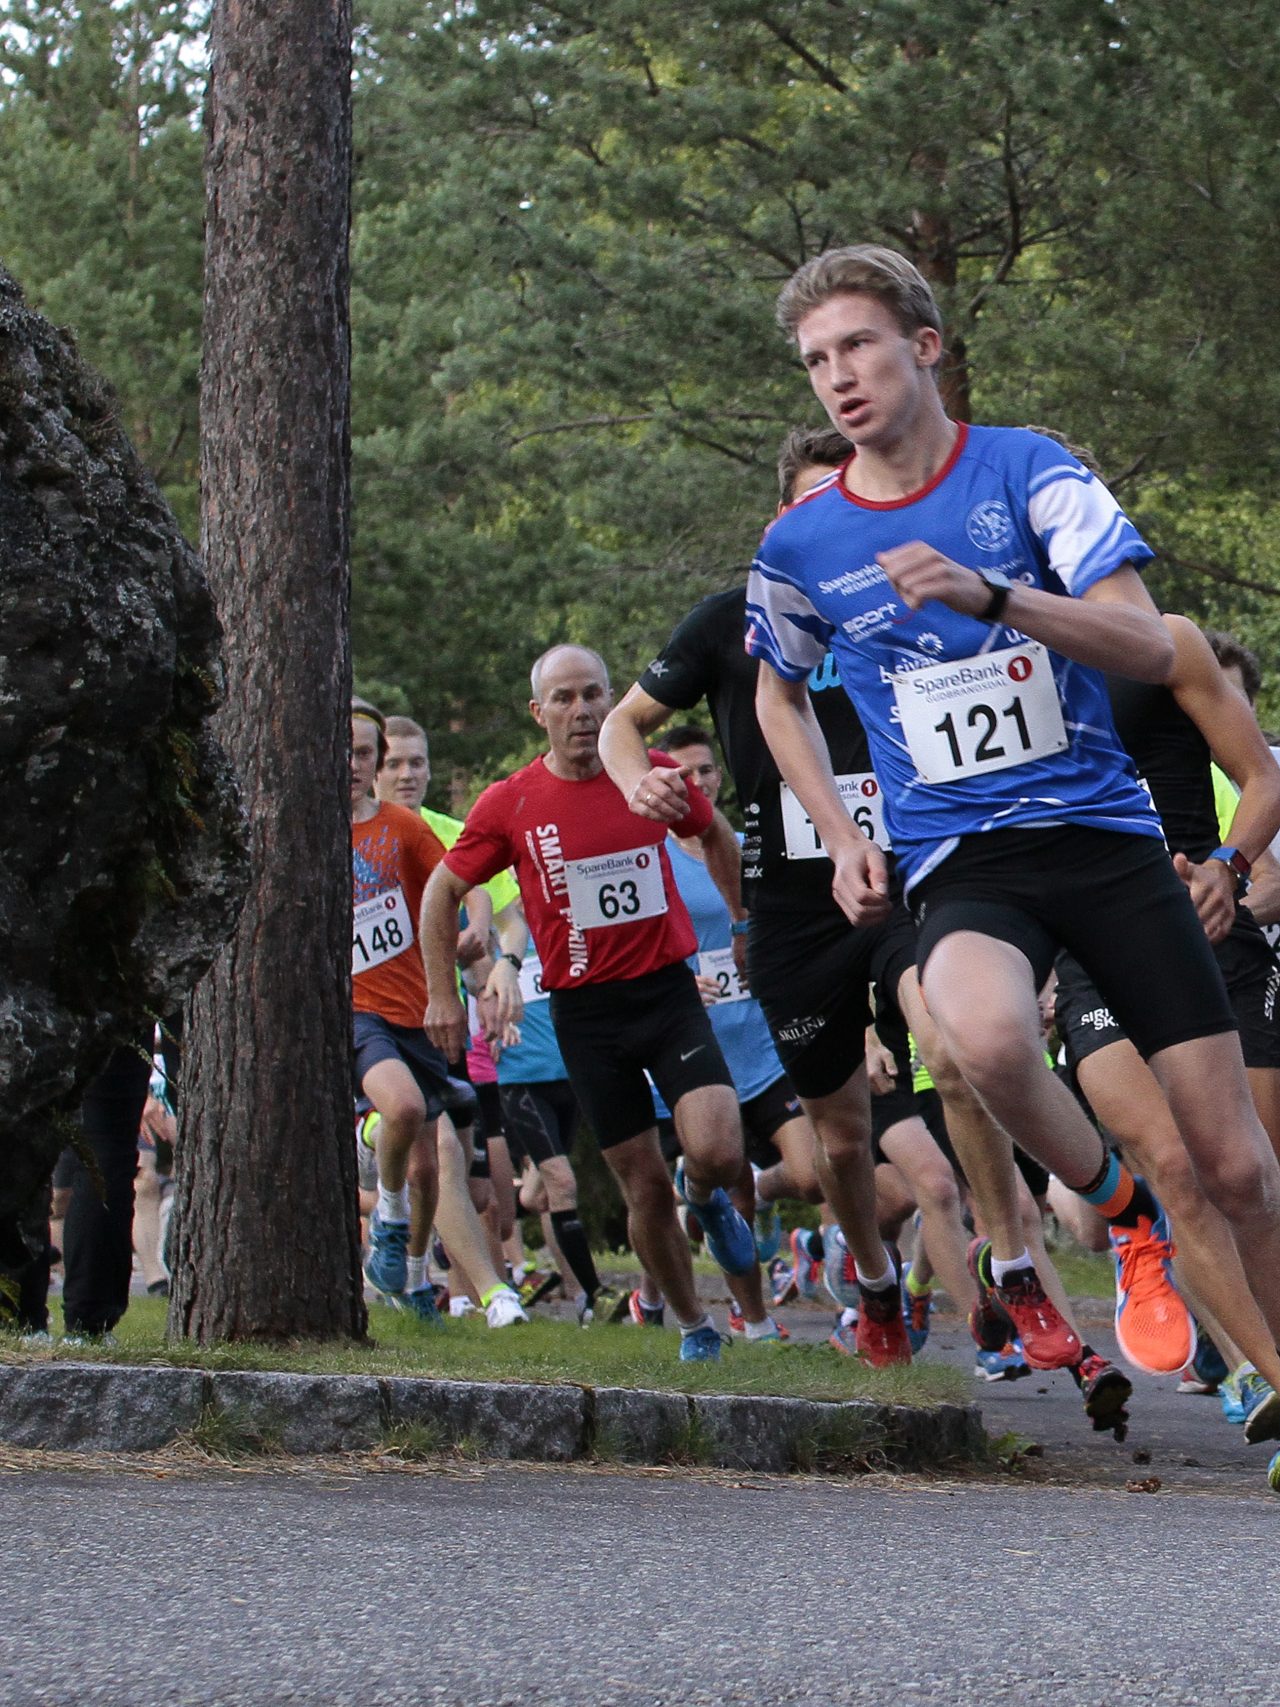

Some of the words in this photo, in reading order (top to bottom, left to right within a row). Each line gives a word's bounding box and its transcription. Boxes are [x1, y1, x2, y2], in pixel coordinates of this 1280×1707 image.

[914, 660, 1006, 695] SpareBank
[934, 696, 1032, 768] 121
[576, 857, 634, 876] SpareBank
[598, 880, 641, 920] 63
[353, 917, 404, 962] 148
